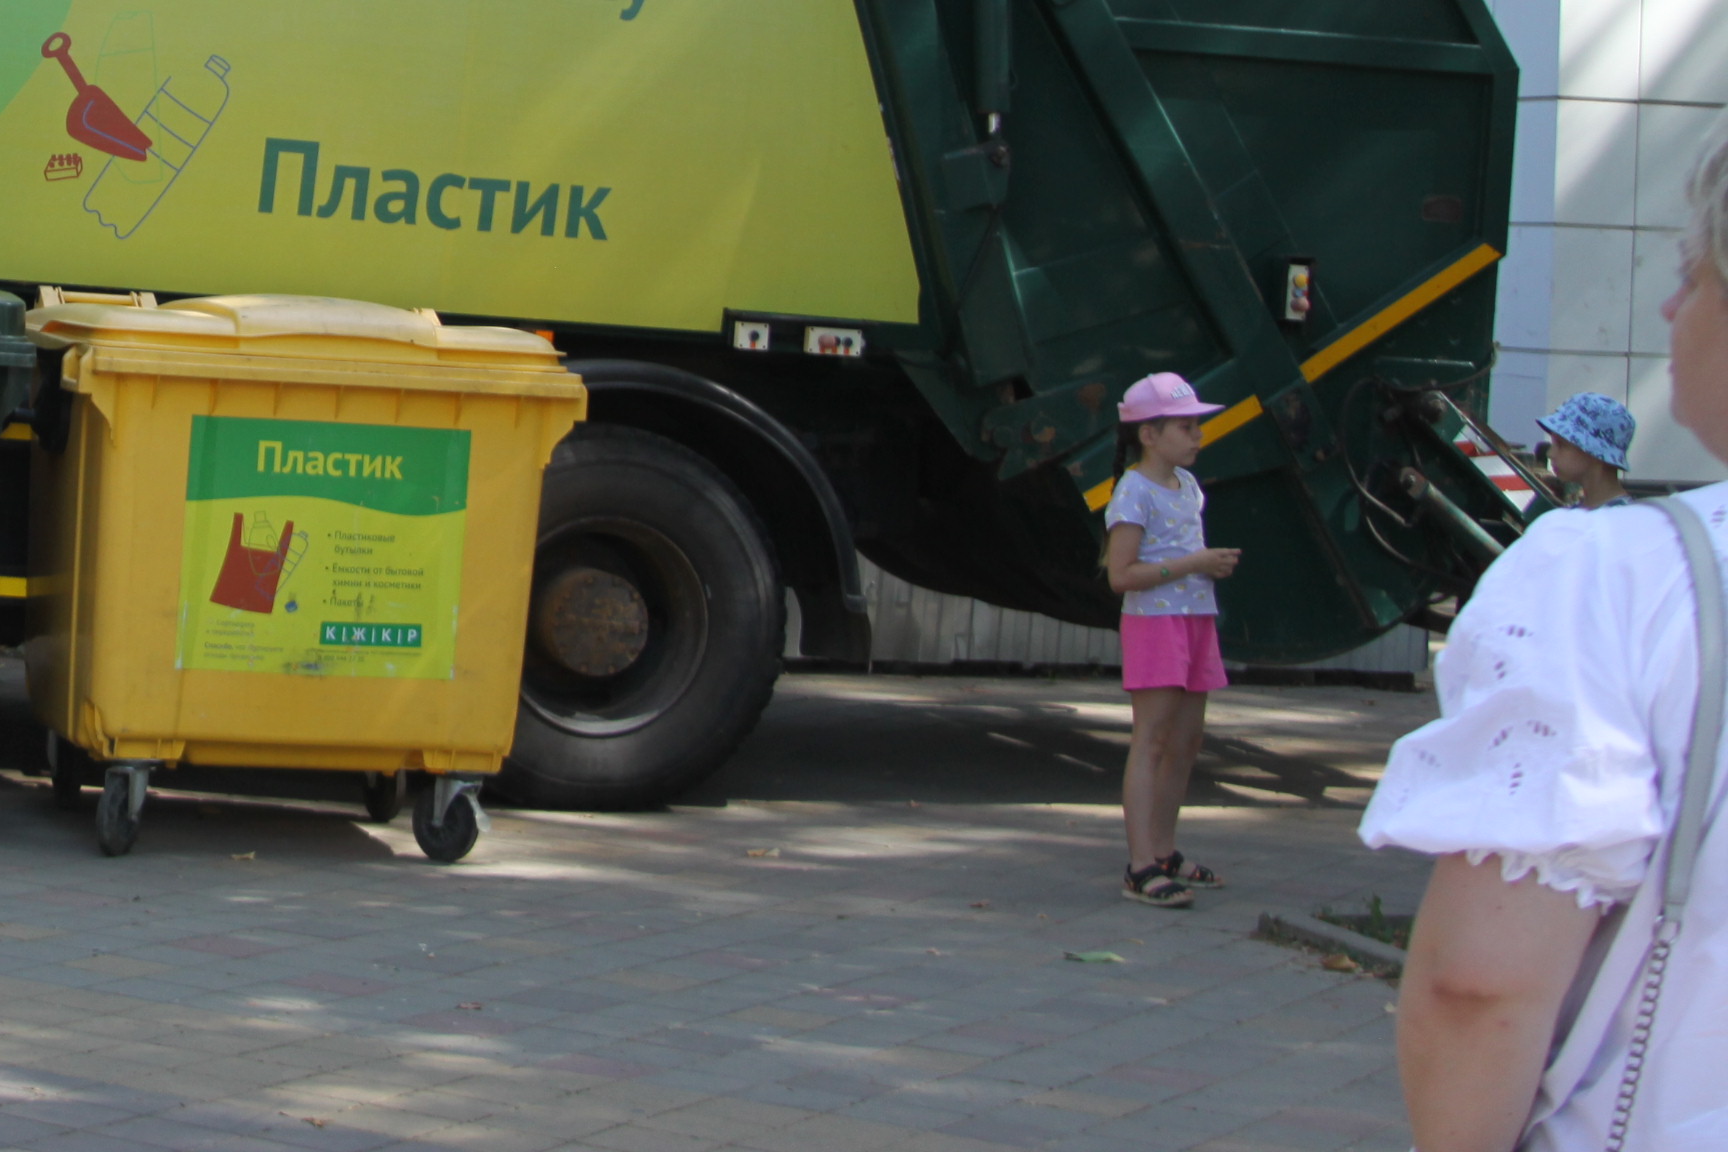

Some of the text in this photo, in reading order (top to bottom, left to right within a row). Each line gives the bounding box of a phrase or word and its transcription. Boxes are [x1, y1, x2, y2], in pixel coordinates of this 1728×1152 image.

[258, 136, 613, 241] Пластик
[256, 439, 404, 480] Пластик
[334, 530, 396, 543] Пластиковые
[334, 544, 374, 556] бутылки
[372, 567, 383, 576] от
[384, 566, 424, 577] бытовой
[373, 581, 422, 590] косметики
